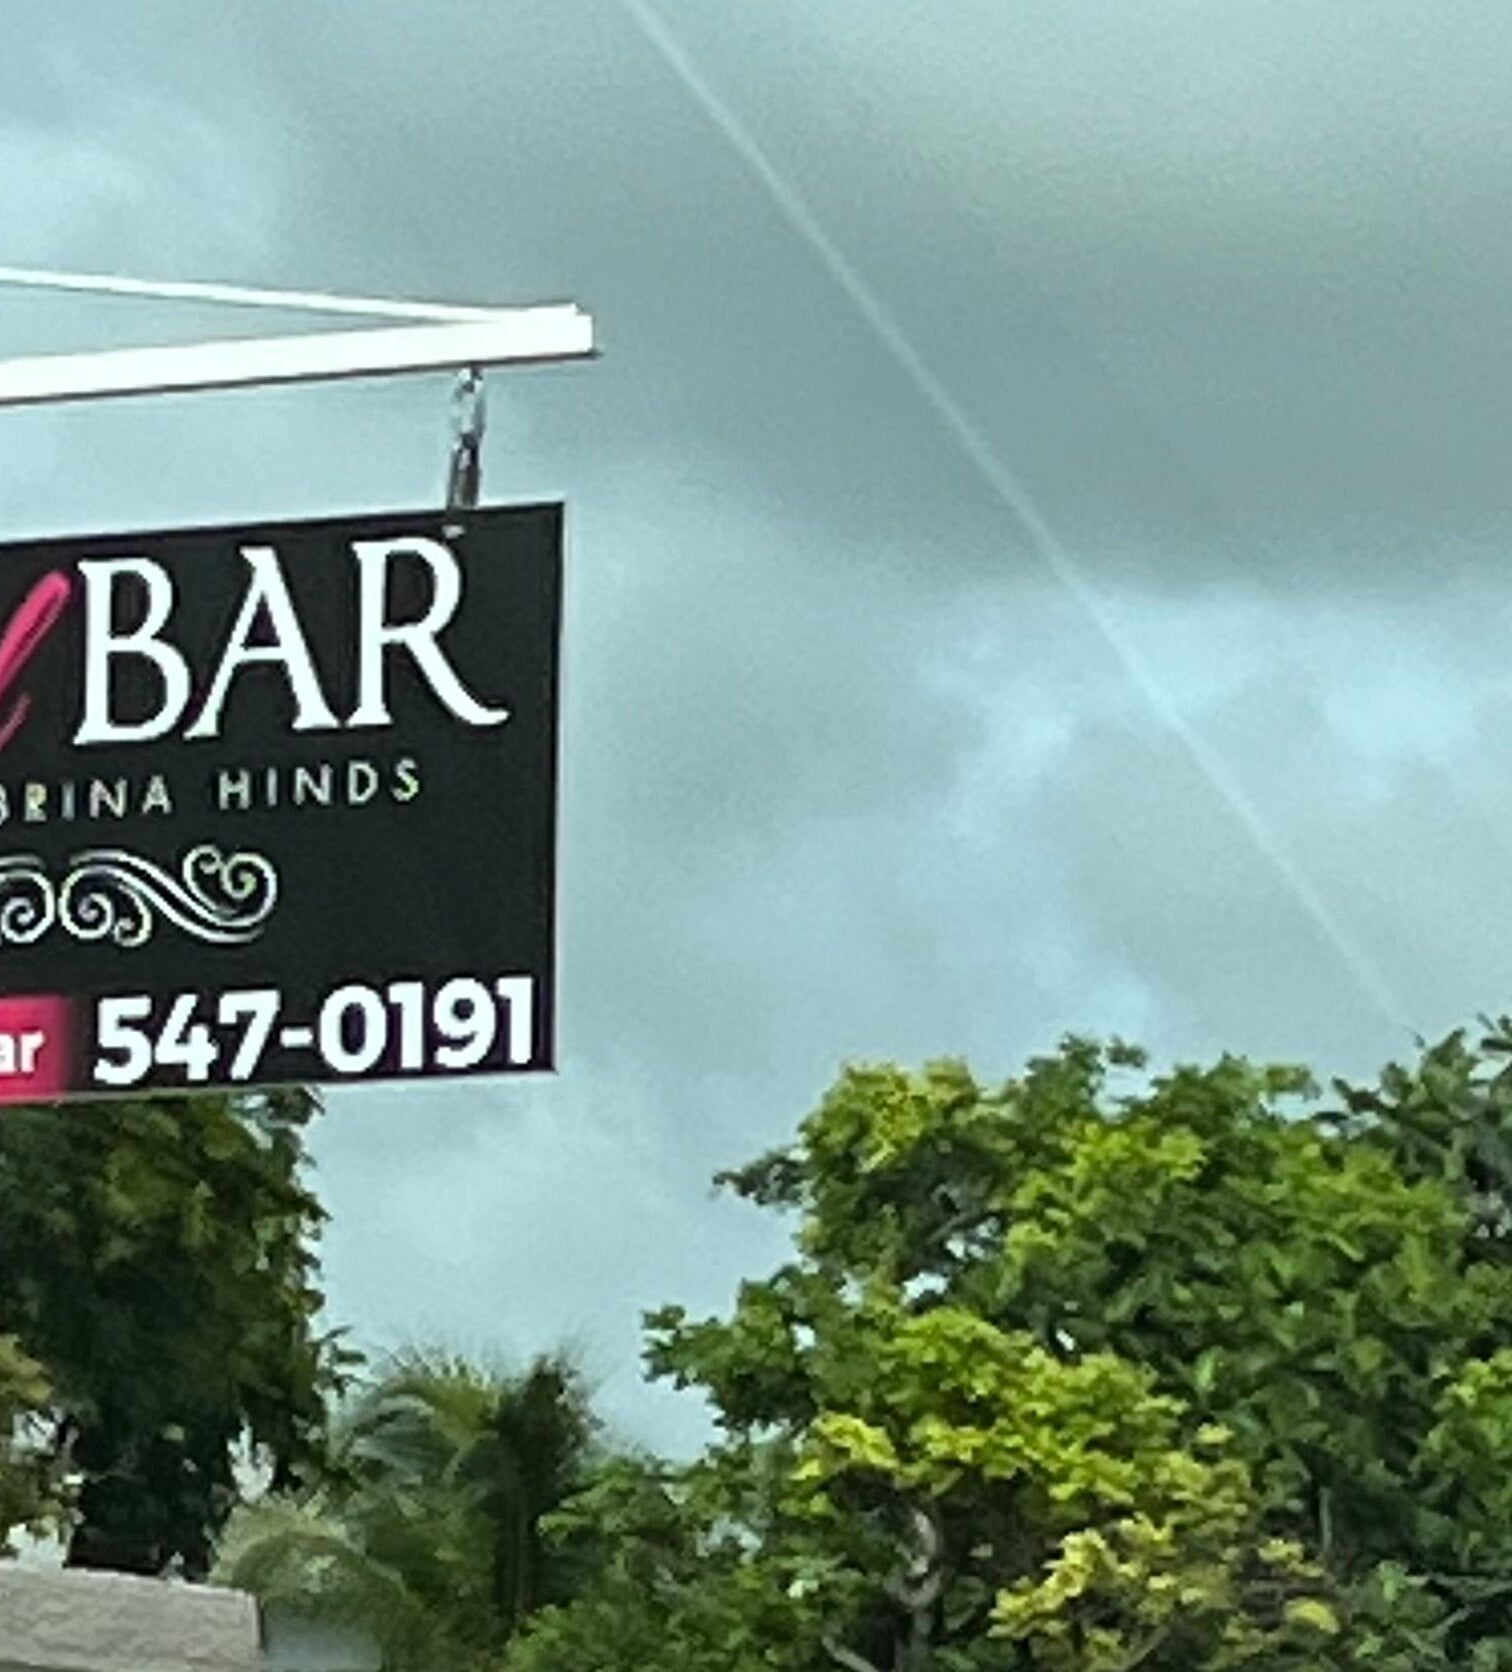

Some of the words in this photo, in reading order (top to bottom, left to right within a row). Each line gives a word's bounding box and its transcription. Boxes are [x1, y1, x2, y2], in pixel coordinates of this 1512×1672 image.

[72, 536, 510, 746] BAR
[218, 757, 420, 811] HINDS
[93, 977, 534, 1086] 547-0191
